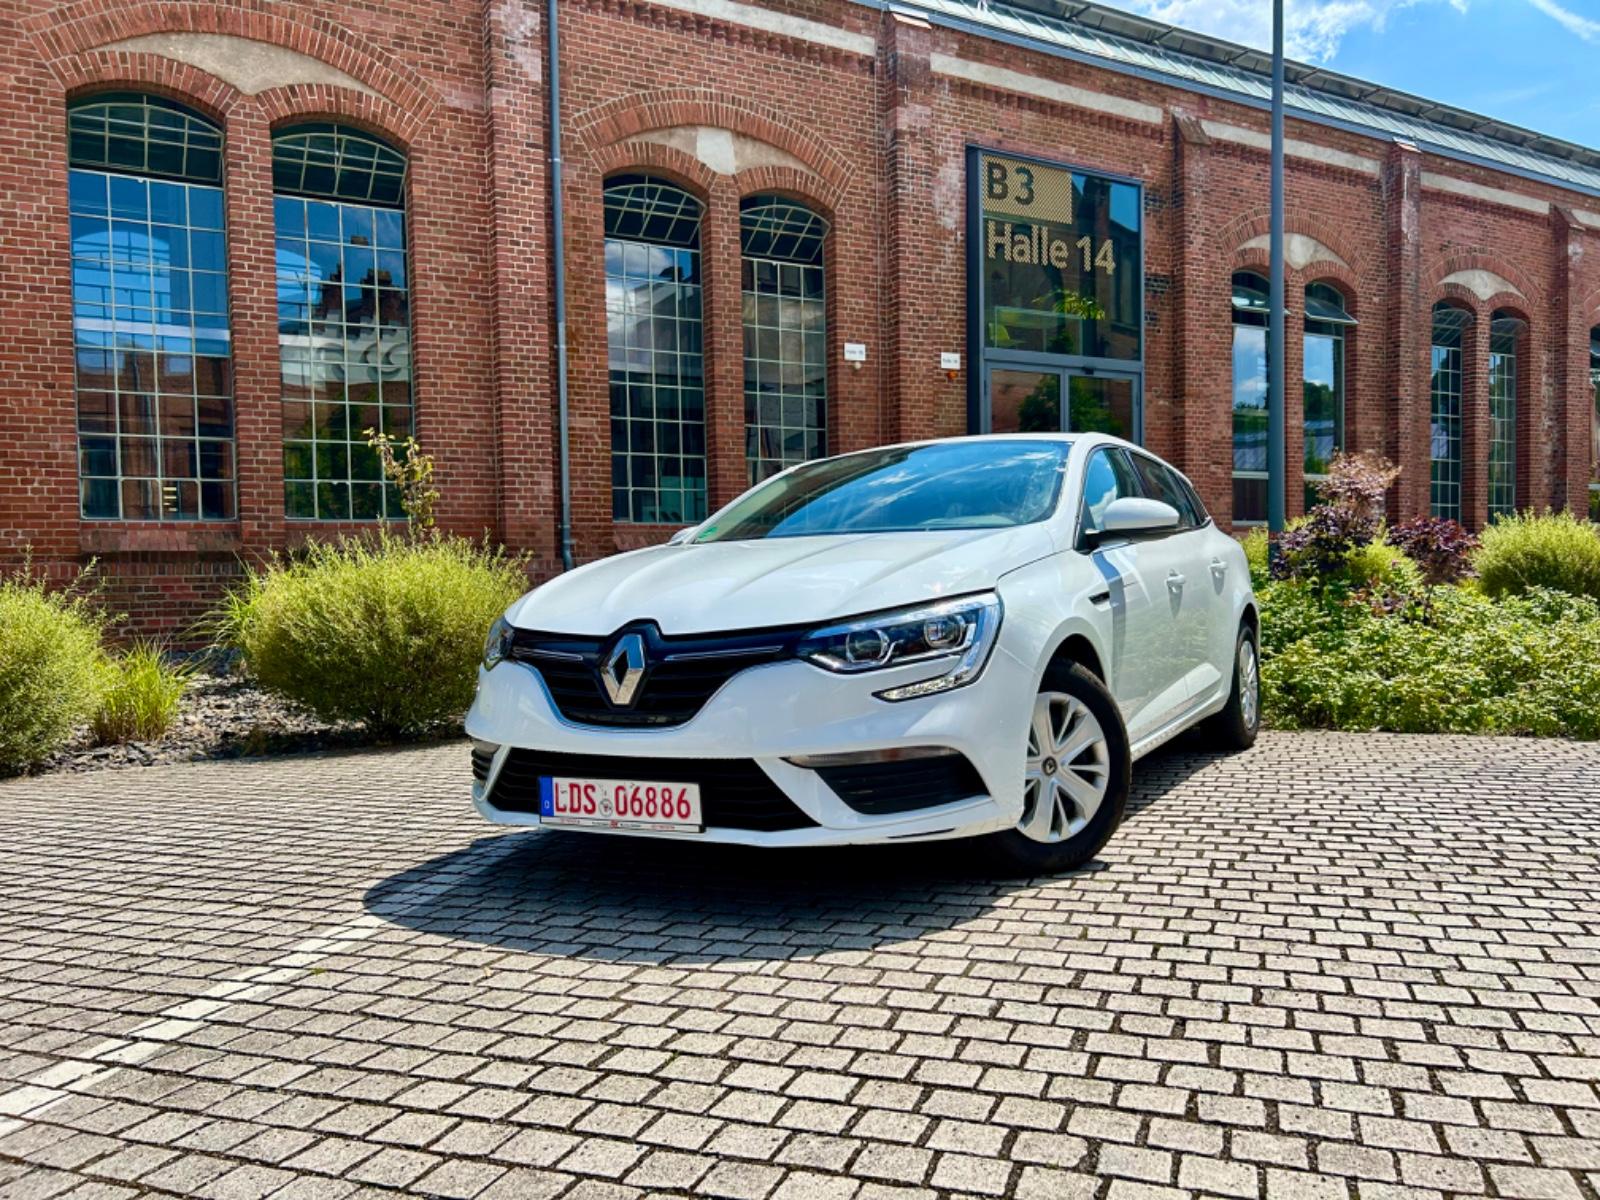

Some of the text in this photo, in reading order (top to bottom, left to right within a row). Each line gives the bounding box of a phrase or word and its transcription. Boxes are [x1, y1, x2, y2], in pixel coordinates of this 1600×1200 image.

[988, 220, 1116, 275] Halle 14
[555, 782, 691, 820] LDS 06886
